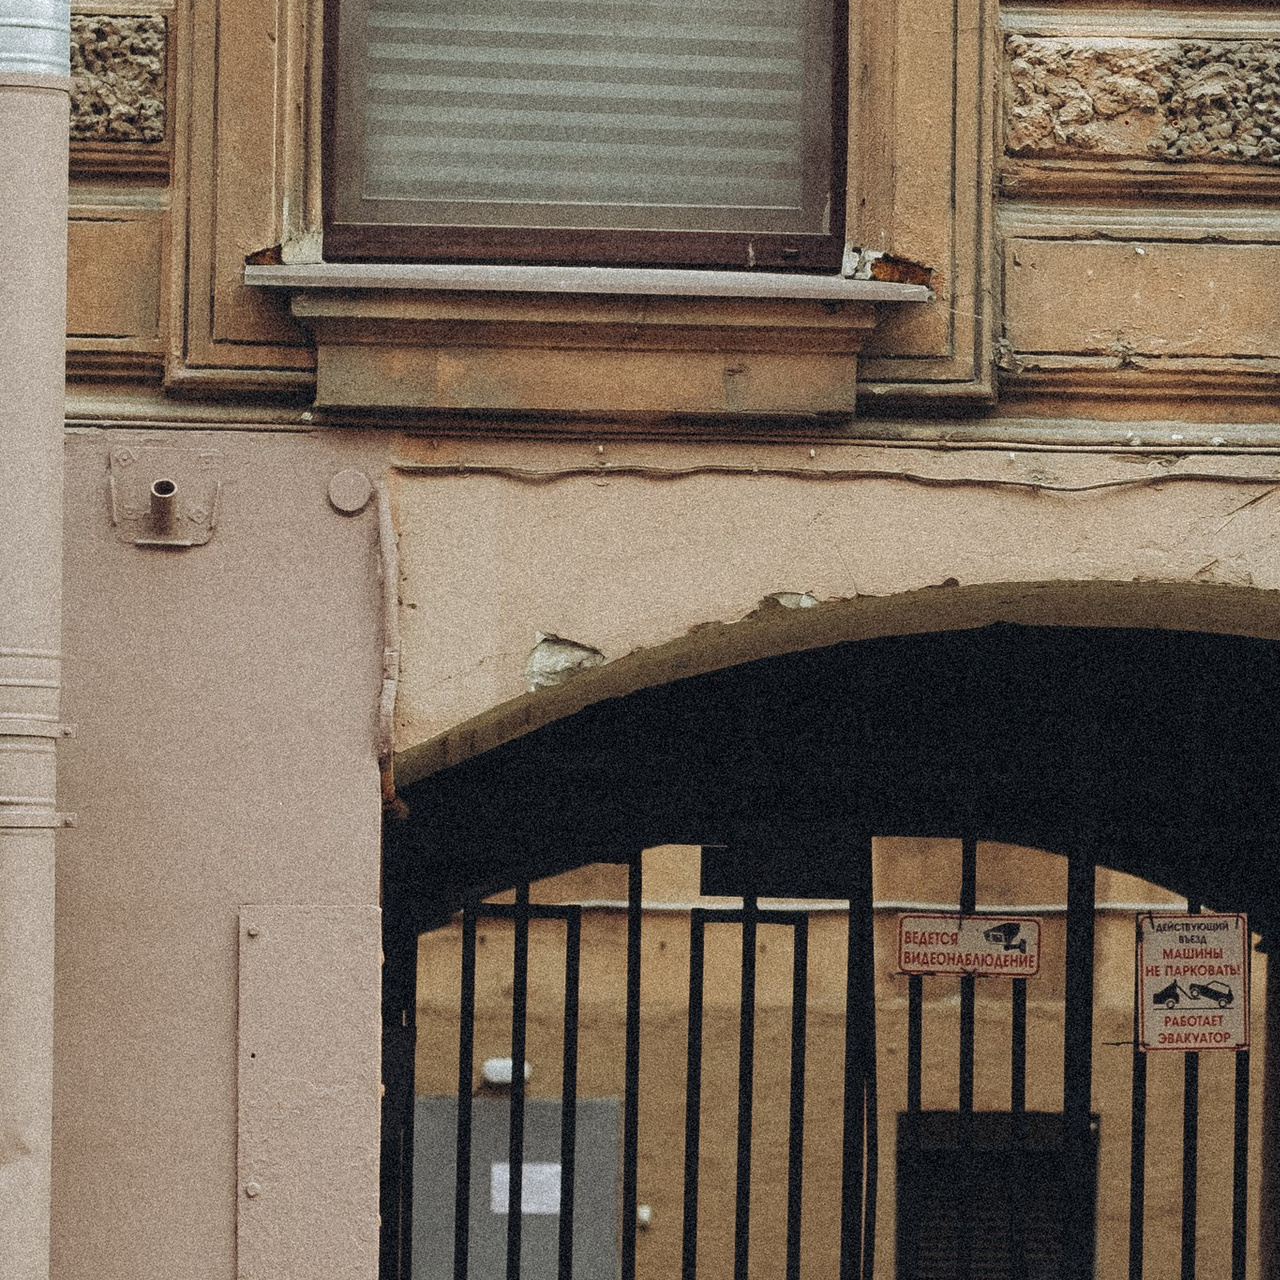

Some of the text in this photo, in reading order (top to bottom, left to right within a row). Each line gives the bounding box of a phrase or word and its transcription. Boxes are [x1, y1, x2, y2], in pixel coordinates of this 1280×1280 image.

[1156, 922, 1229, 933] ДЕЙСТВУЮЩИЙ
[904, 931, 958, 946] ВЕДЕТСЯ
[1178, 935, 1207, 945] ВЪЕЗД
[904, 951, 1036, 969] ВИДЕОНАБЛЮДЕНИЕ
[1162, 948, 1223, 960] МАШИНЫ
[1145, 965, 1240, 977] НЕ ПАРКОВАТЬ!
[1164, 1015, 1223, 1027] РАБОТАЕТ
[1158, 1032, 1231, 1044] ЭВАКУАТОР
